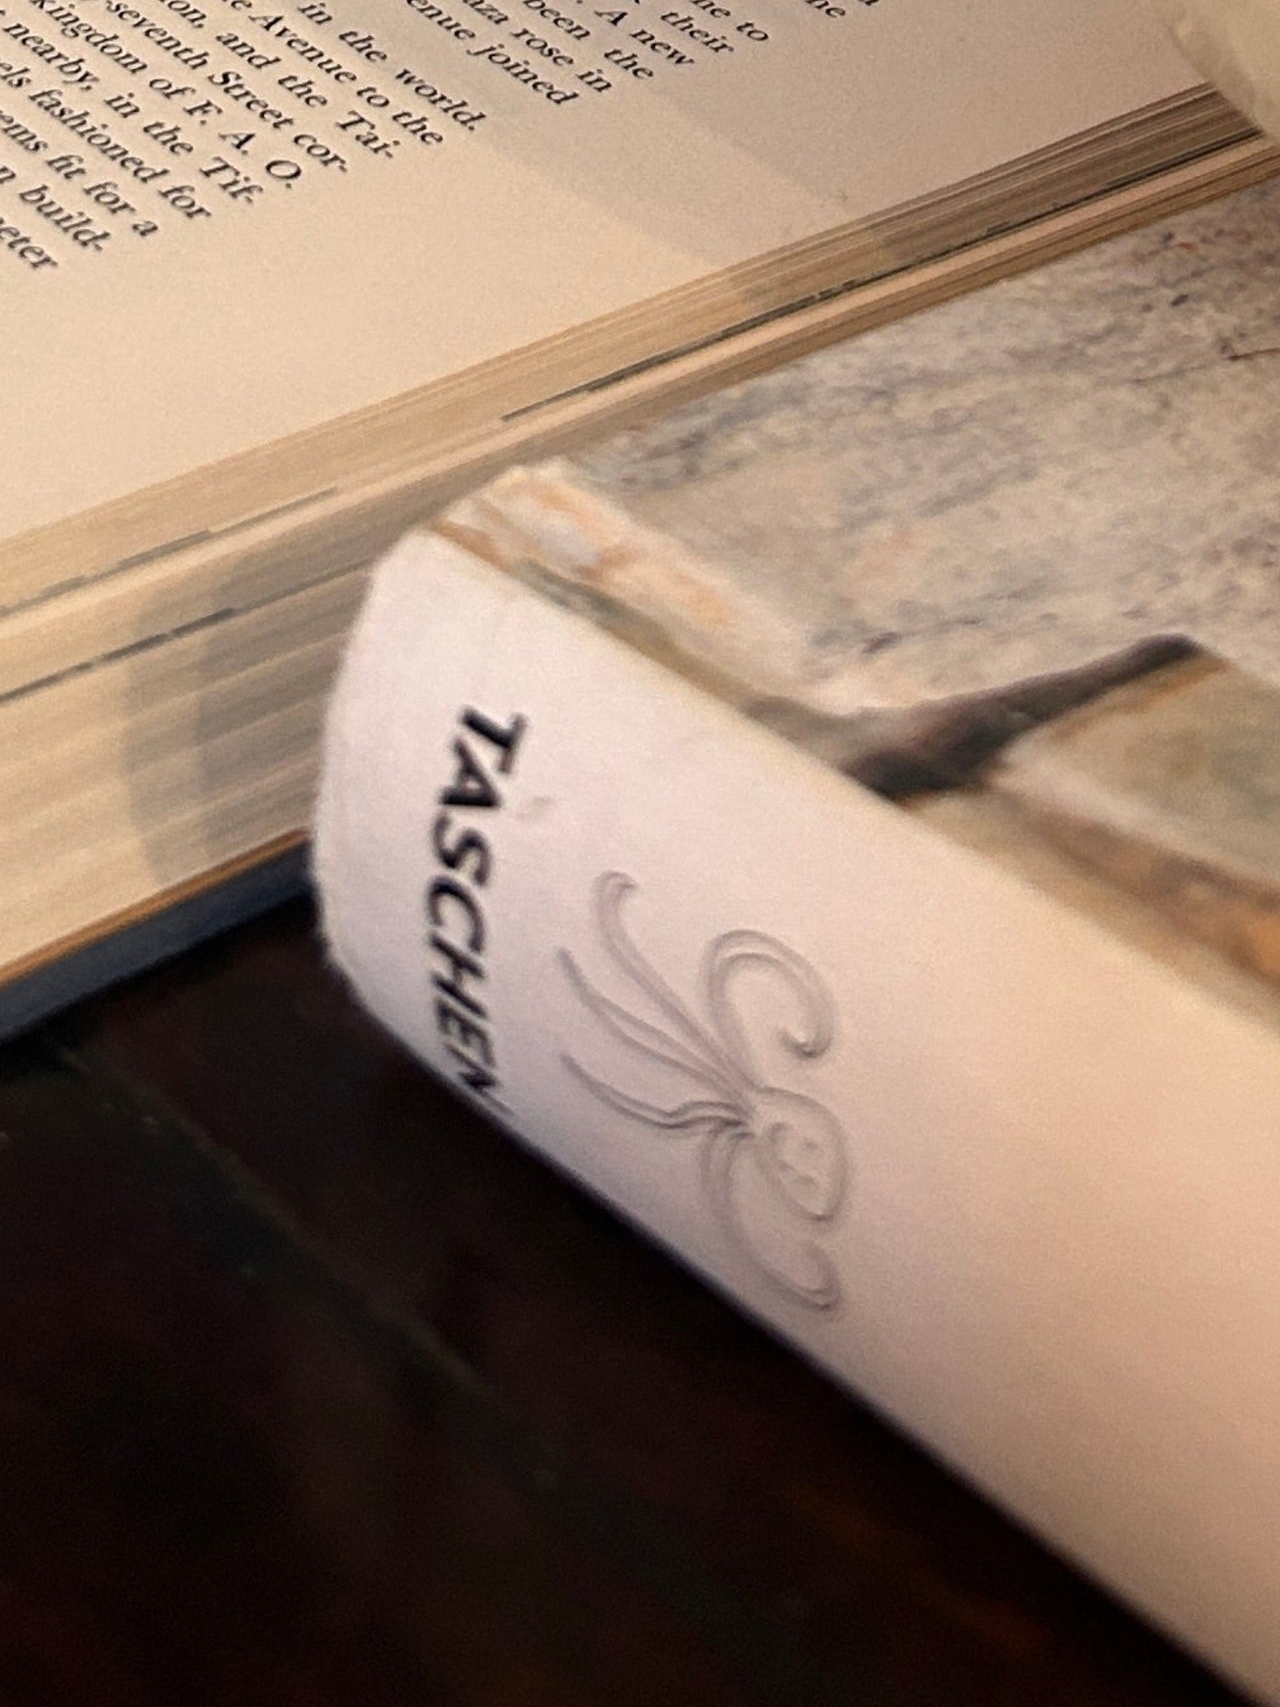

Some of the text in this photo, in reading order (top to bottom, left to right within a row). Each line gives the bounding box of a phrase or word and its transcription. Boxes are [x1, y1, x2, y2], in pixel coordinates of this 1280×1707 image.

[247, 15, 358, 85] Avenue
[508, 27, 575, 68] rose
[602, 48, 655, 80] the
[628, 28, 696, 66] new
[659, 10, 735, 54] their
[394, 68, 488, 132] world.
[467, 43, 581, 106] joined
[1, 22, 101, 93] nearby,
[197, 155, 264, 205] Tif-
[181, 88, 224, 127] F.
[218, 132, 257, 157] A.
[264, 159, 303, 190] O.
[206, 70, 295, 131] Street
[291, 133, 348, 174] cor-
[334, 109, 401, 160] Tai-
[26, 88, 170, 185] fashioned
[156, 184, 213, 221] for
[17, 183, 112, 253] build-
[81, 180, 137, 217] for
[426, 703, 526, 1116] TASCHEN
